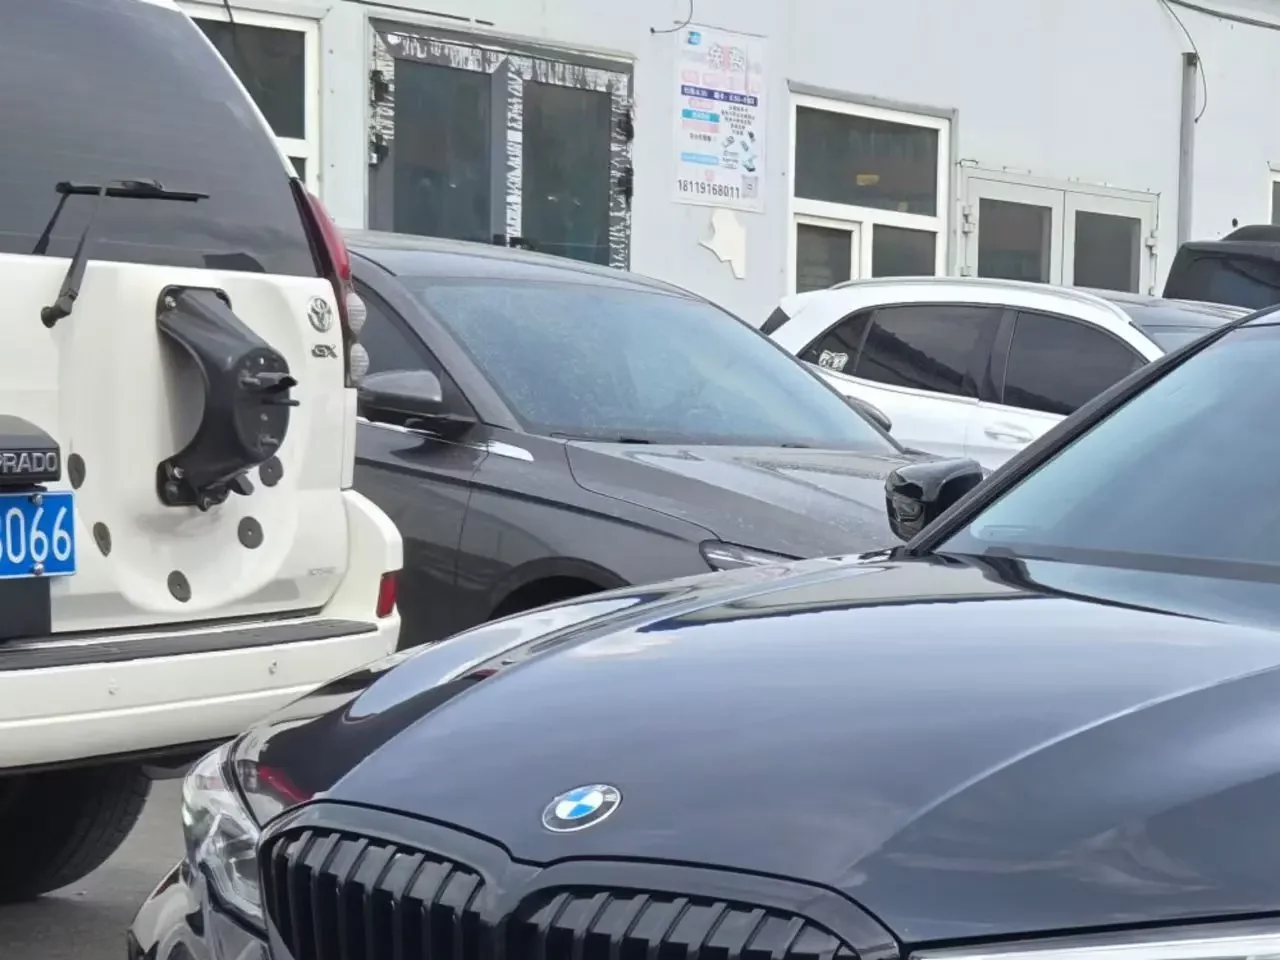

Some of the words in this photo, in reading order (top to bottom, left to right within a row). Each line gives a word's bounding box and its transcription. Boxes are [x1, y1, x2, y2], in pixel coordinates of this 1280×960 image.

[677, 179, 740, 199] 18119168011
[0, 452, 57, 473] RADO
[0, 506, 71, 563] 066
